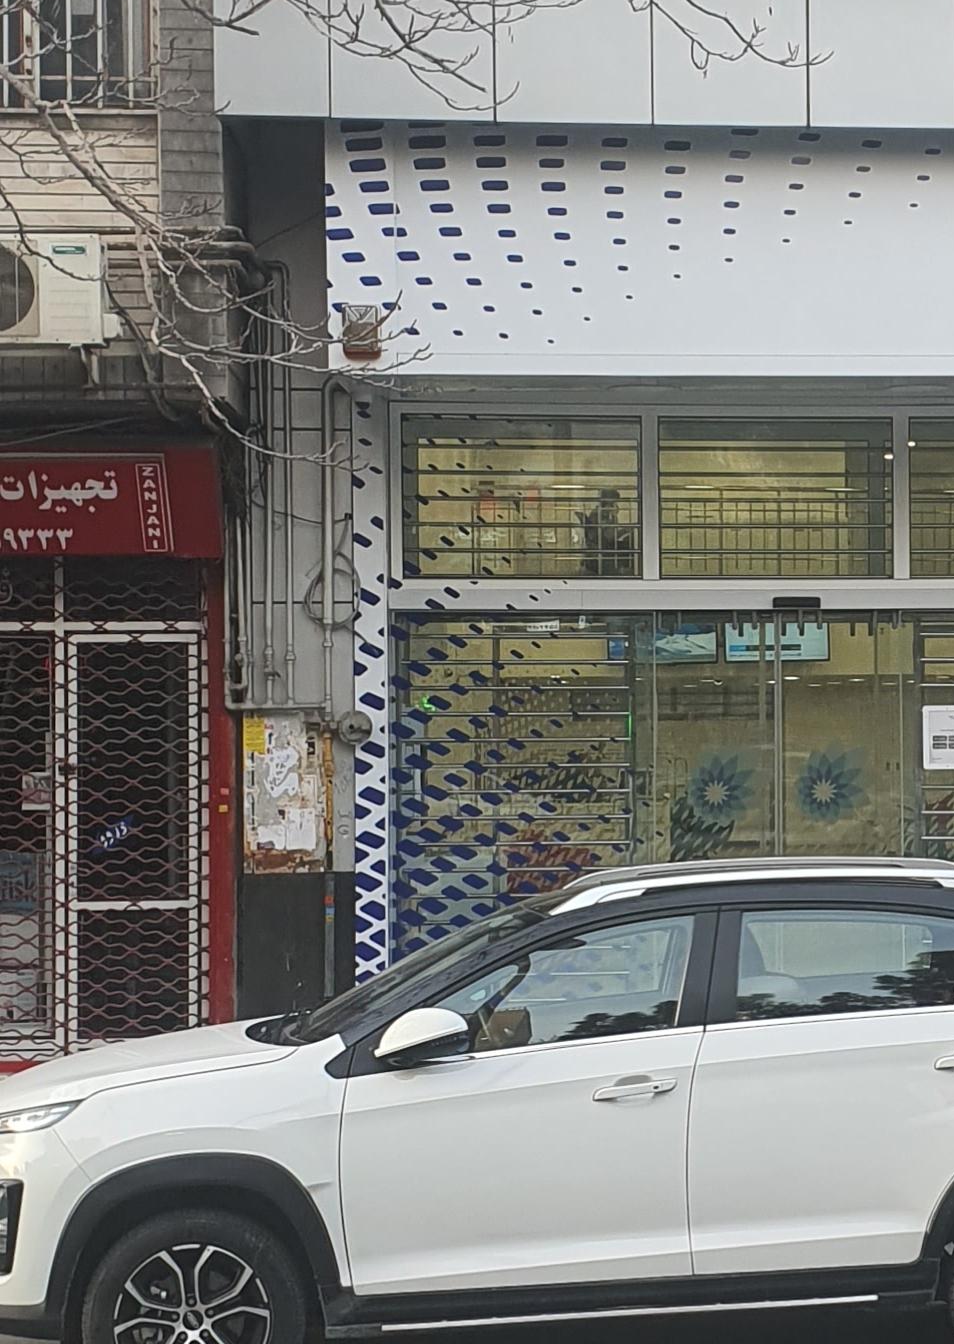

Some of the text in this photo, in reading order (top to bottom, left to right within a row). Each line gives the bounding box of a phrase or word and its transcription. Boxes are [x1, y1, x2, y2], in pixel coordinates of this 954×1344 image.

[0, 469, 118, 513] تجهیزات
[142, 466, 162, 549] ZANJANI
[0, 527, 74, 551] ۹۳۳۳
